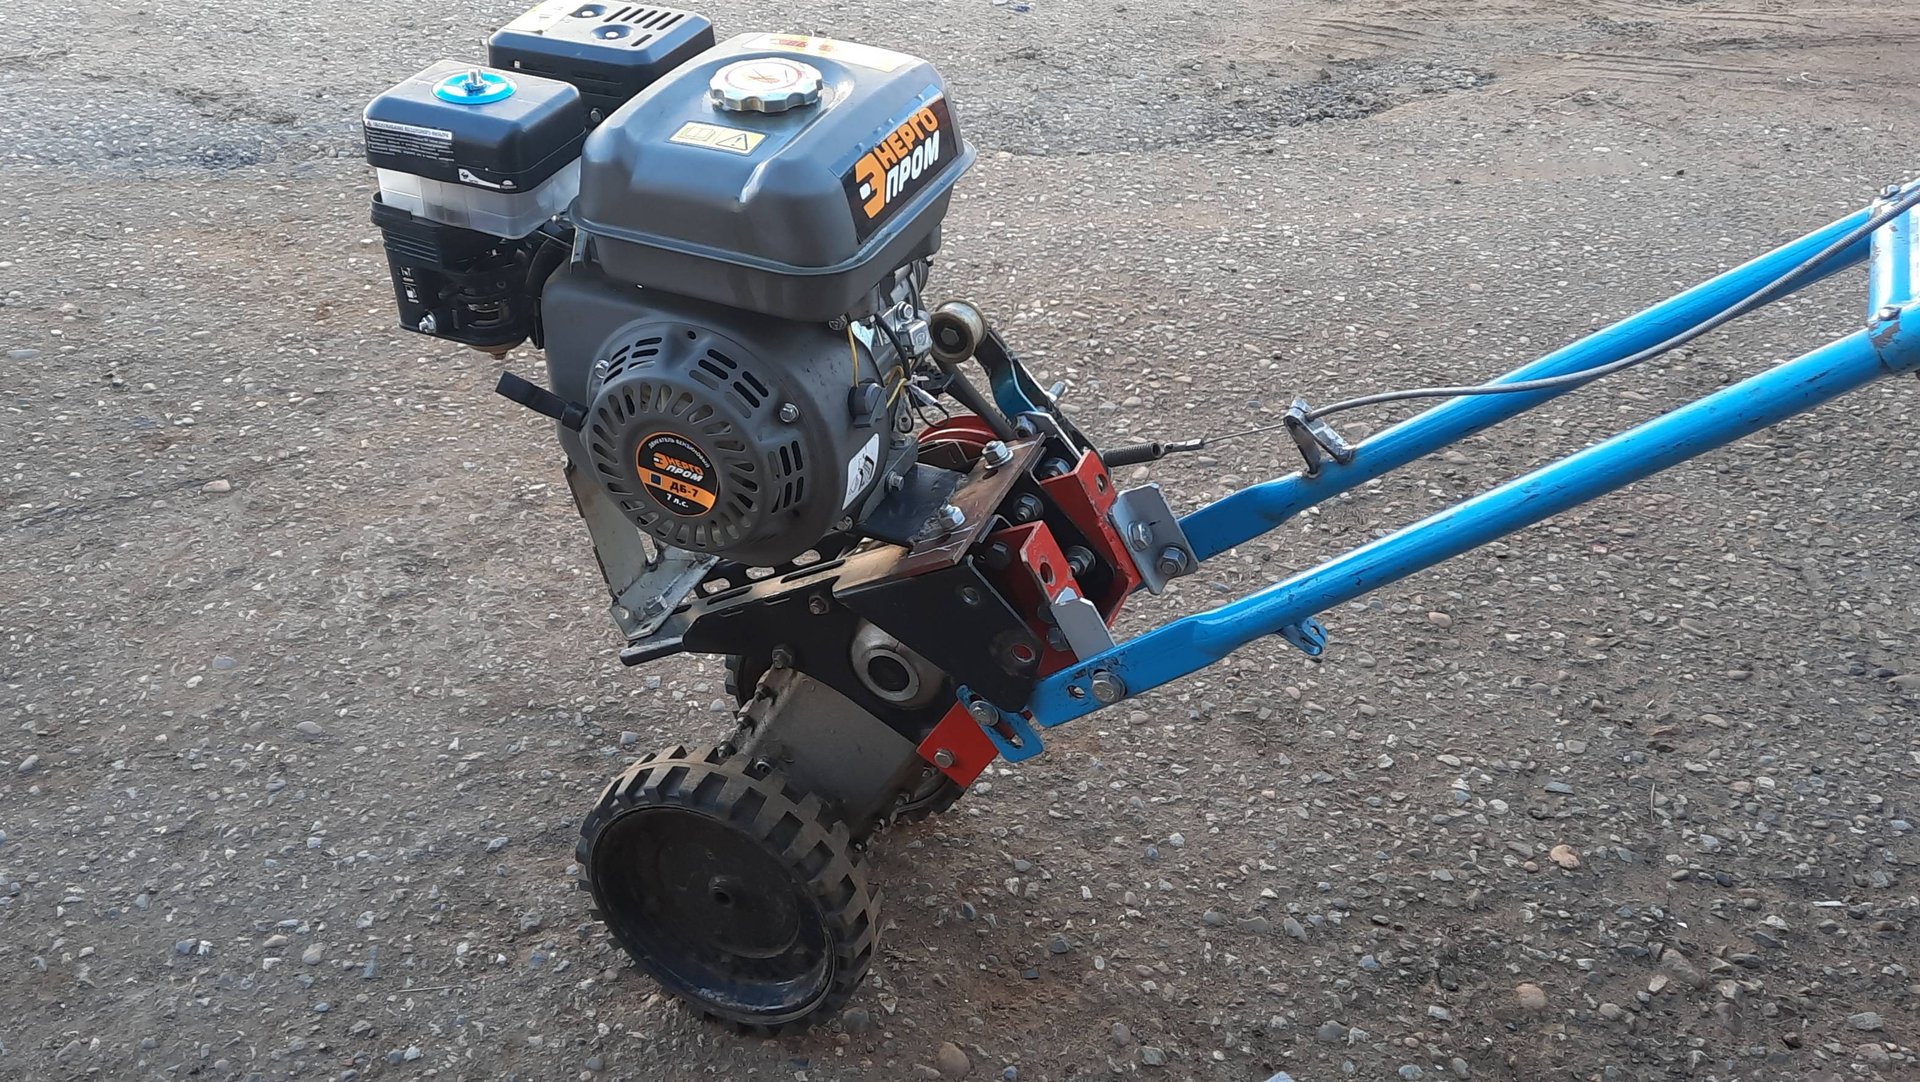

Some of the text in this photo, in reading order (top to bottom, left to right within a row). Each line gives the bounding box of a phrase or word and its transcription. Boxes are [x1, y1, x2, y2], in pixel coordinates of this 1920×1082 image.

[855, 106, 938, 219] ЭНЕРГО
[885, 130, 940, 204] ПРОМ
[653, 451, 704, 476] ЭНЕРГО
[665, 464, 703, 482] ПРОМ
[666, 493, 672, 501] 7
[669, 480, 699, 497] ДБ-7
